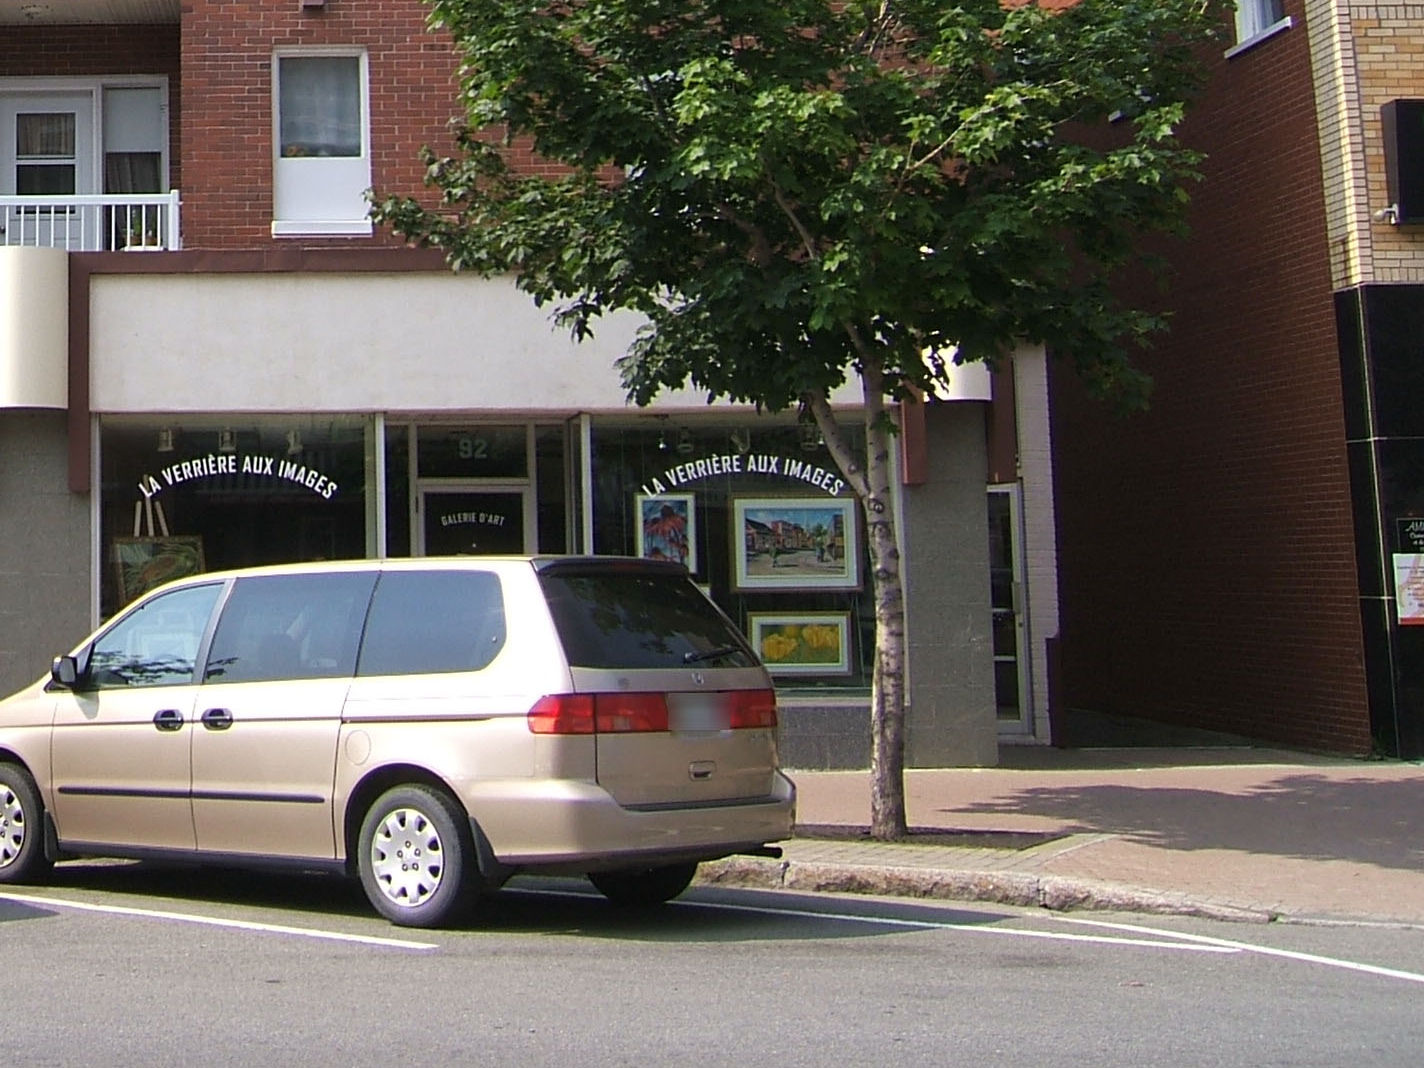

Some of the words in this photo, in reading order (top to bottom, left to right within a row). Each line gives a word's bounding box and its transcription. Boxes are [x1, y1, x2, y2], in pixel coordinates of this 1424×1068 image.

[459, 438, 488, 459] 92
[138, 476, 162, 499] LA
[161, 454, 237, 486] VERRIÈRE
[242, 455, 275, 475] AUX
[278, 459, 338, 499] IMAGES
[642, 477, 666, 498] LA
[665, 453, 742, 486] VERRIÈRE
[747, 454, 779, 475] AUX
[783, 458, 845, 497] IMAGES
[441, 512, 476, 526] GALERIE
[479, 512, 505, 526] D'ART
